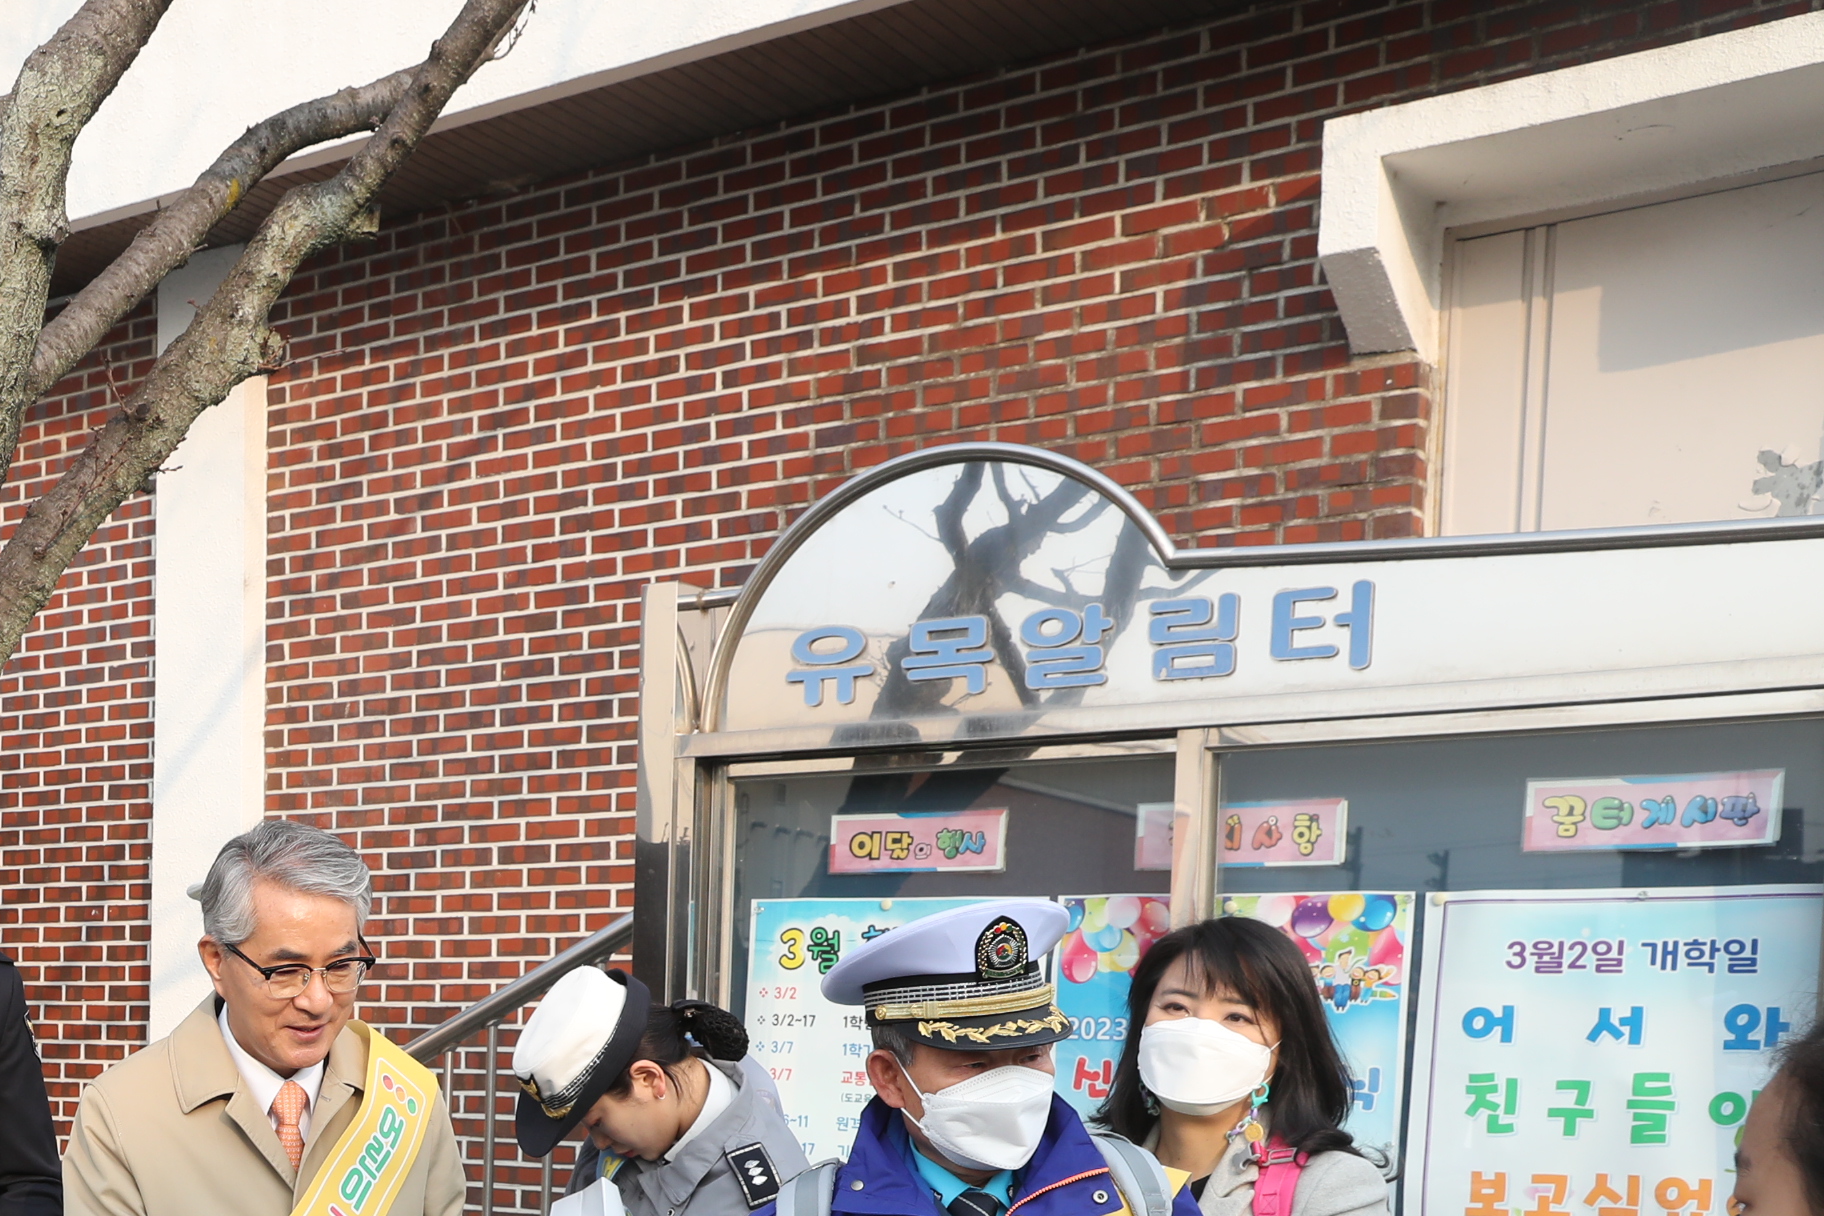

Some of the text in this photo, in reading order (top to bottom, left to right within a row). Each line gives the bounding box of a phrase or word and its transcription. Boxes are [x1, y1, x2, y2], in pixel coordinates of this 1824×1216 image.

[785, 580, 1375, 707] 유목알림터
[936, 828, 987, 860] 행사
[779, 926, 840, 974] 3월
[1505, 938, 1759, 974] 3월2일 개학일
[773, 987, 797, 1000] 3/2
[771, 1013, 816, 1027] 3/2~17
[770, 1041, 794, 1054] 3/7
[341, 1106, 404, 1212] 어린이
